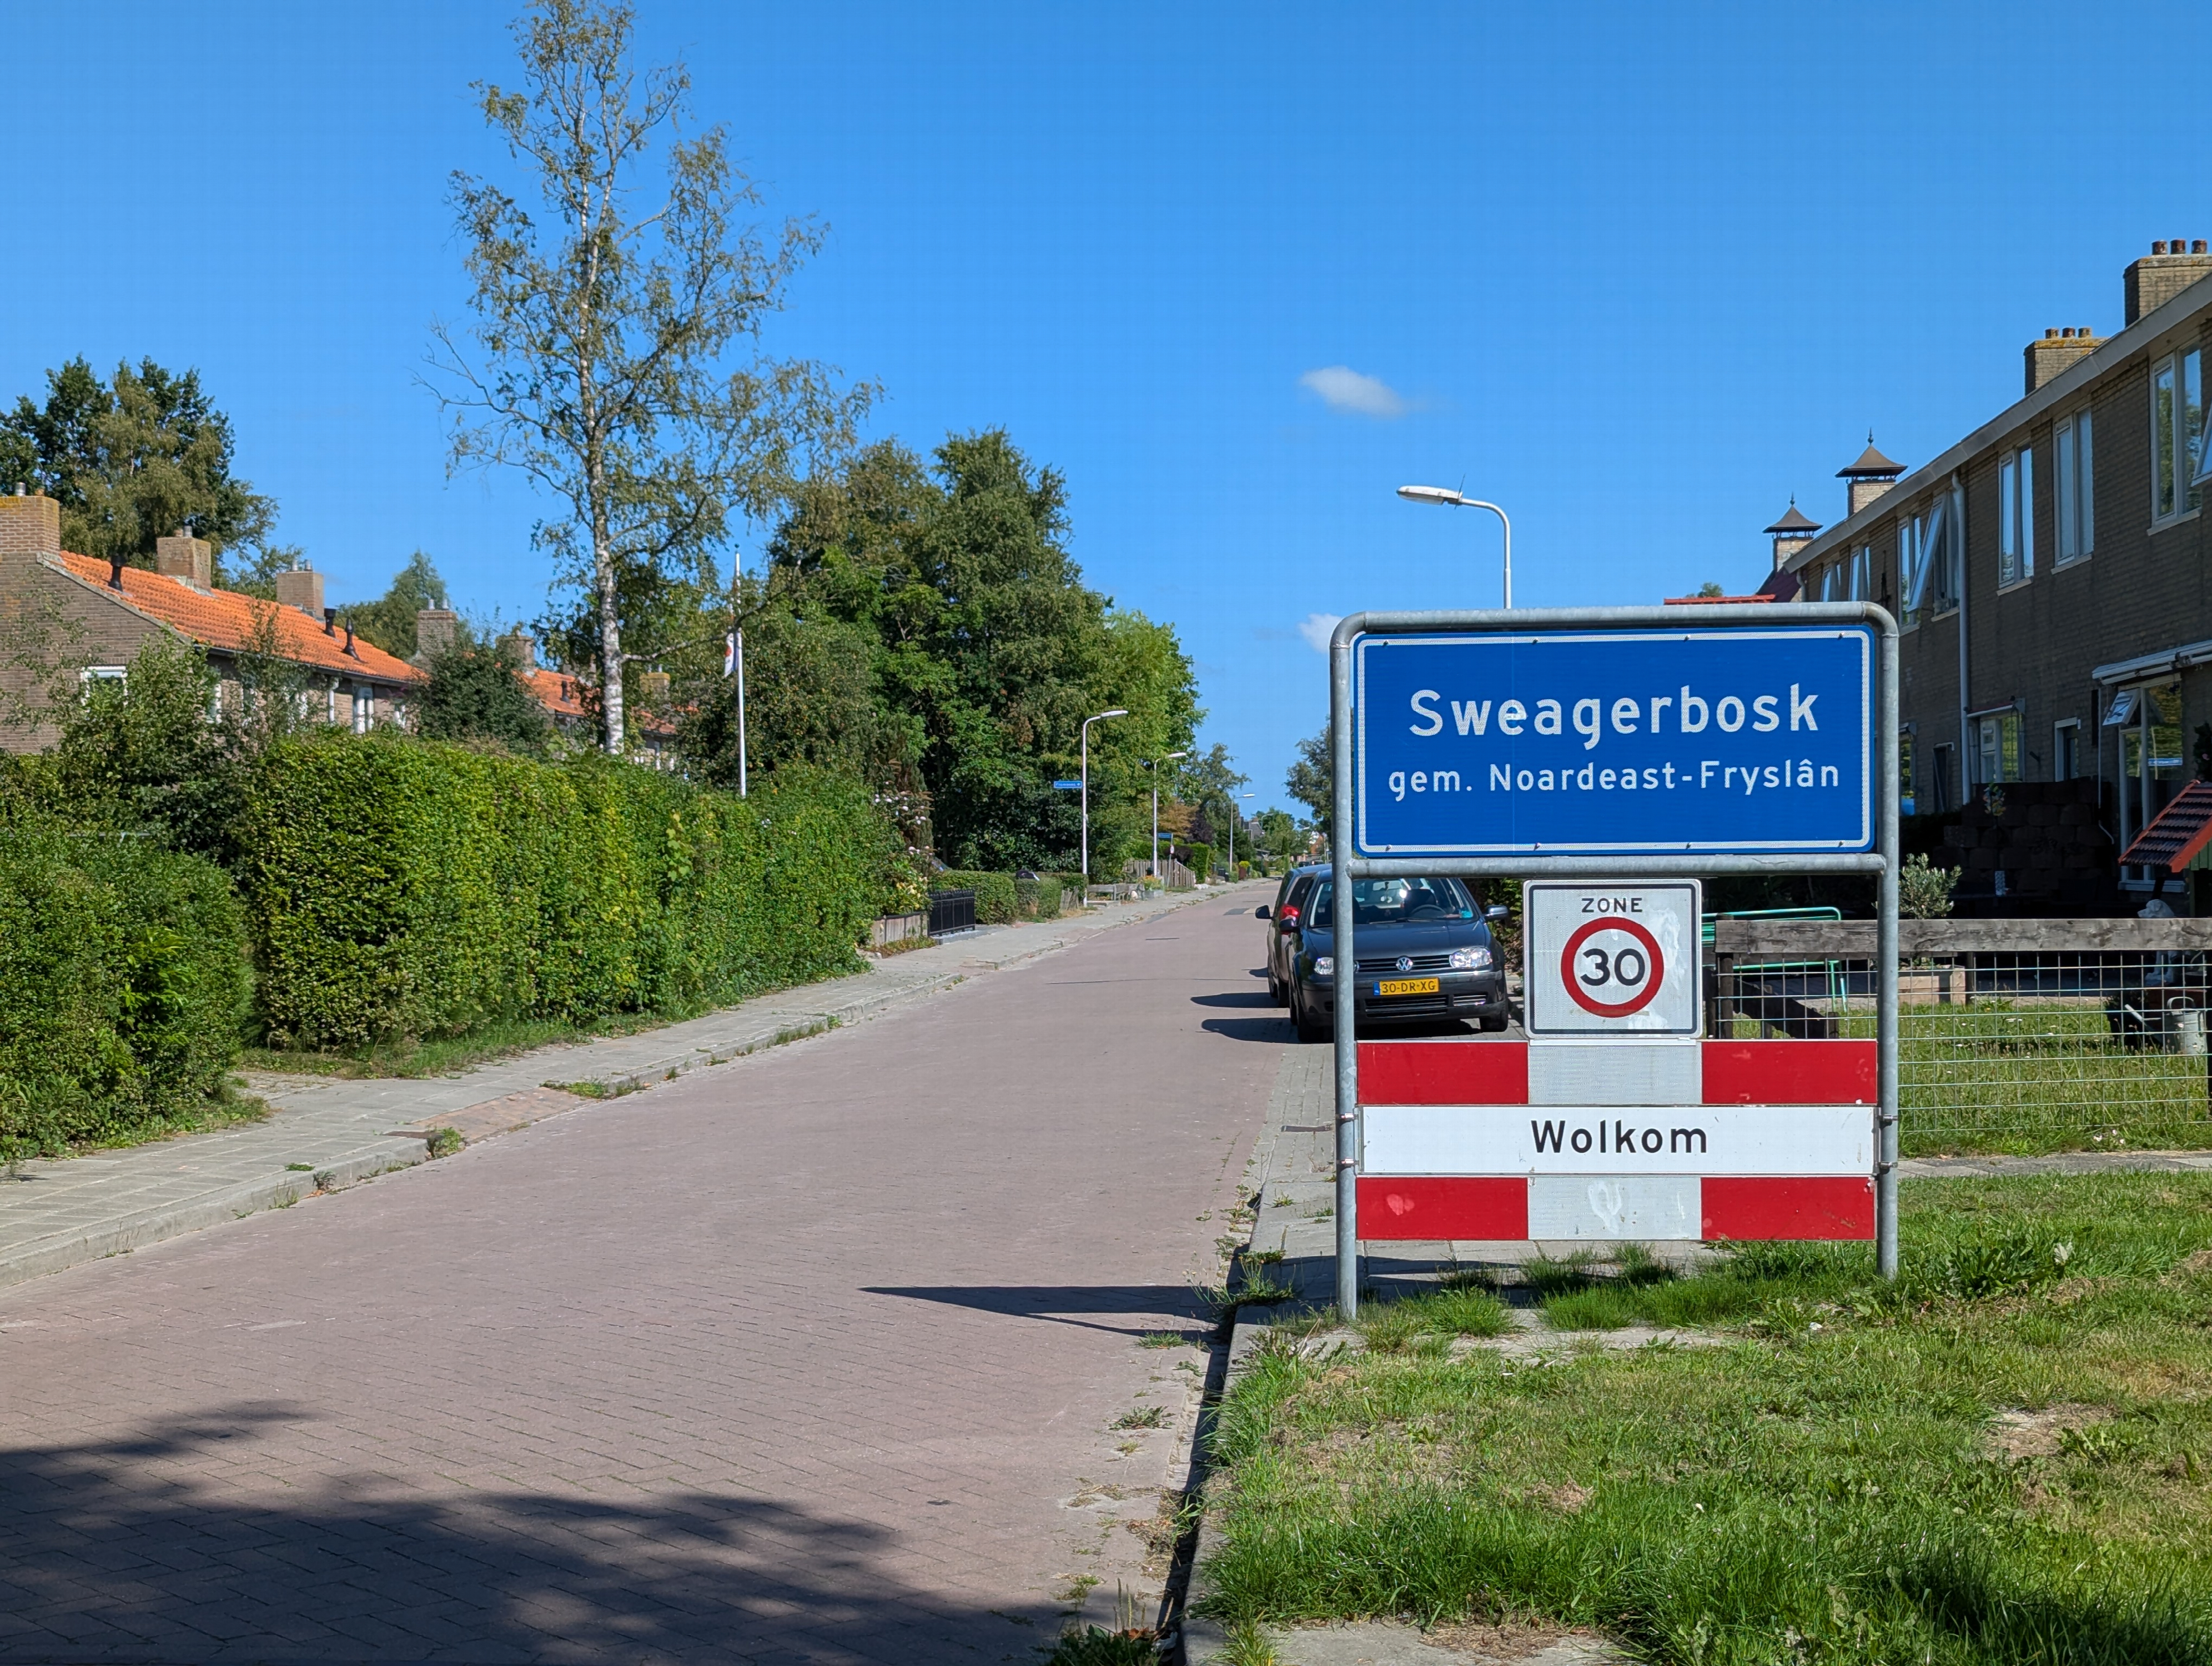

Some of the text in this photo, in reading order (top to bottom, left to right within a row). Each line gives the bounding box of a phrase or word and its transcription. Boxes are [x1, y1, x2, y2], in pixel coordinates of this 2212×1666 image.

[1410, 683, 1818, 750] Sweagerbosk
[1389, 759, 1839, 802] gem. Noardeast-Fryslân
[1581, 897, 1643, 913] ZONE
[1580, 948, 1645, 986] 30
[1381, 980, 1436, 993] 30-DR-XG
[1531, 1120, 1706, 1153] Wolkom
